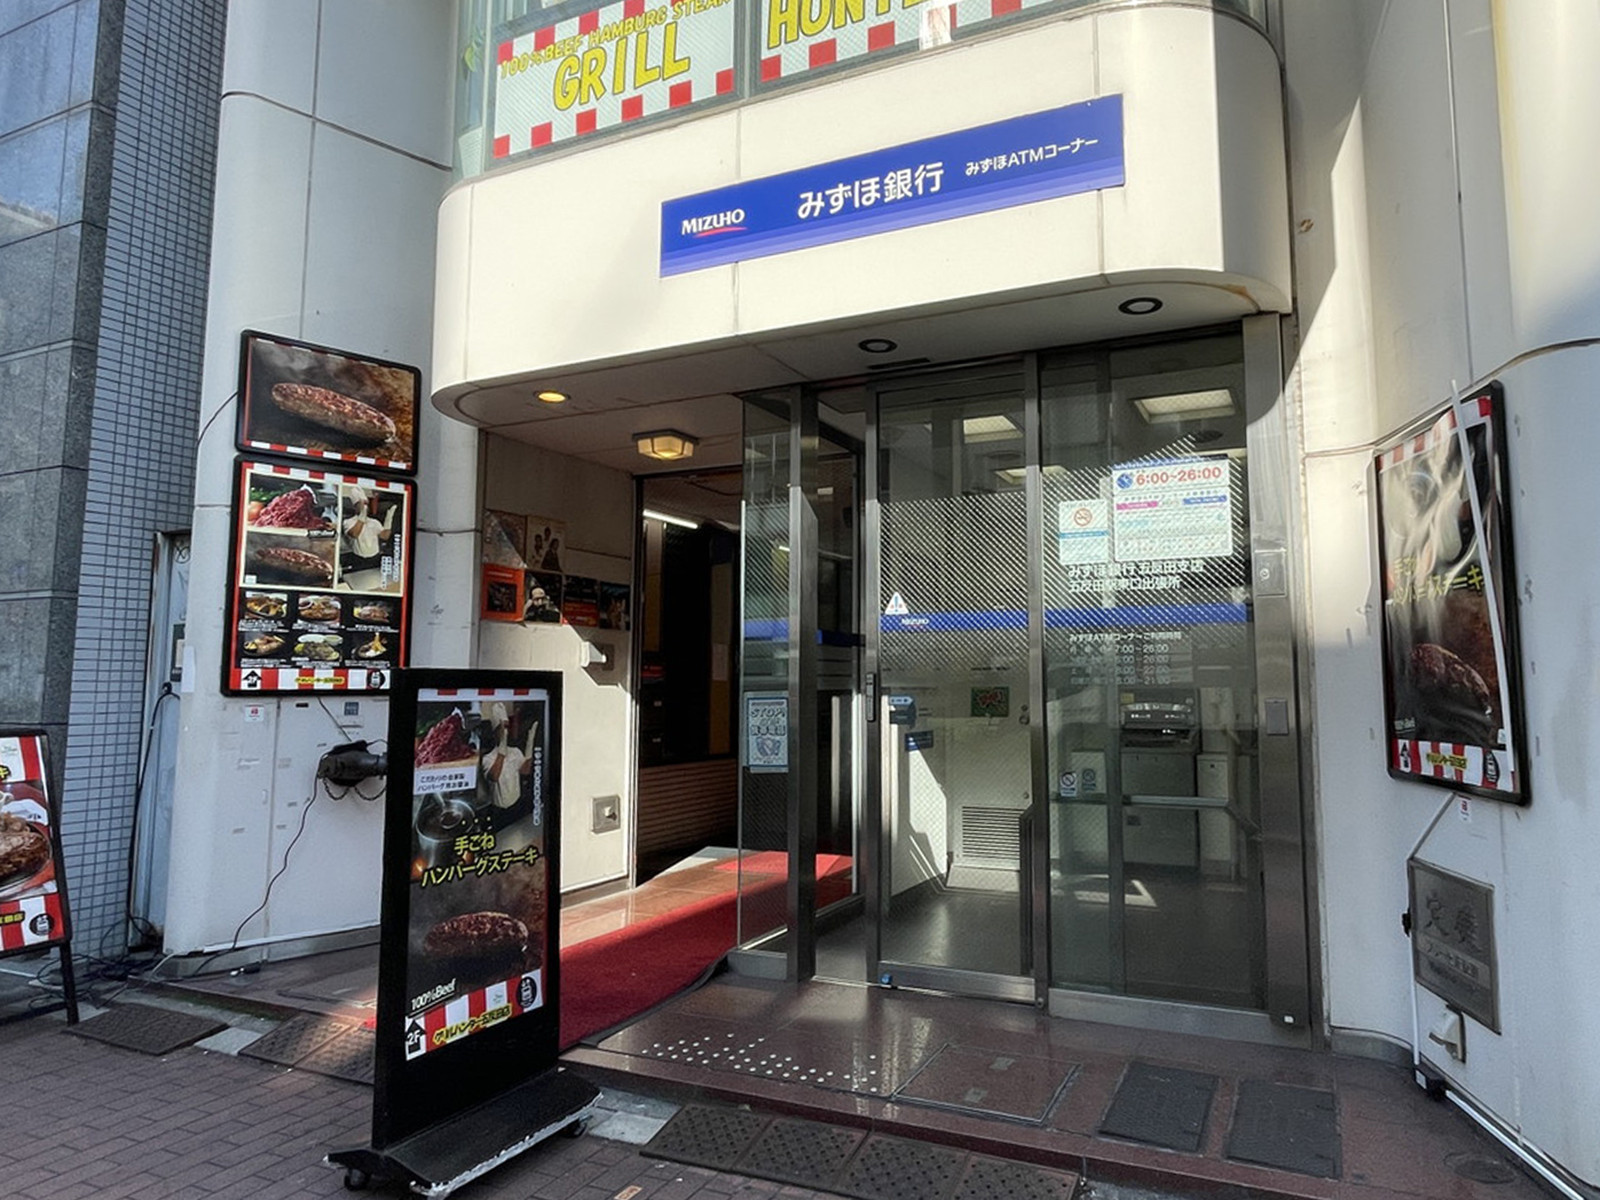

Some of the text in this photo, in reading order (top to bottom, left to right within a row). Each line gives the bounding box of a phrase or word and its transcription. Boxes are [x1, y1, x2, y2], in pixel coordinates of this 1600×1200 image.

[588, 6, 668, 47] HAMBURG
[553, 21, 691, 111] GRILL
[964, 137, 1100, 177] みずほATMコーナー
[797, 161, 945, 220] みずほ銀行
[681, 208, 745, 236] MIZUHO
[454, 832, 495, 855] 手ごね
[421, 847, 538, 887] ハンバーグステーキ
[411, 978, 457, 1010] 100%Beef
[407, 1029, 421, 1046] 2F
